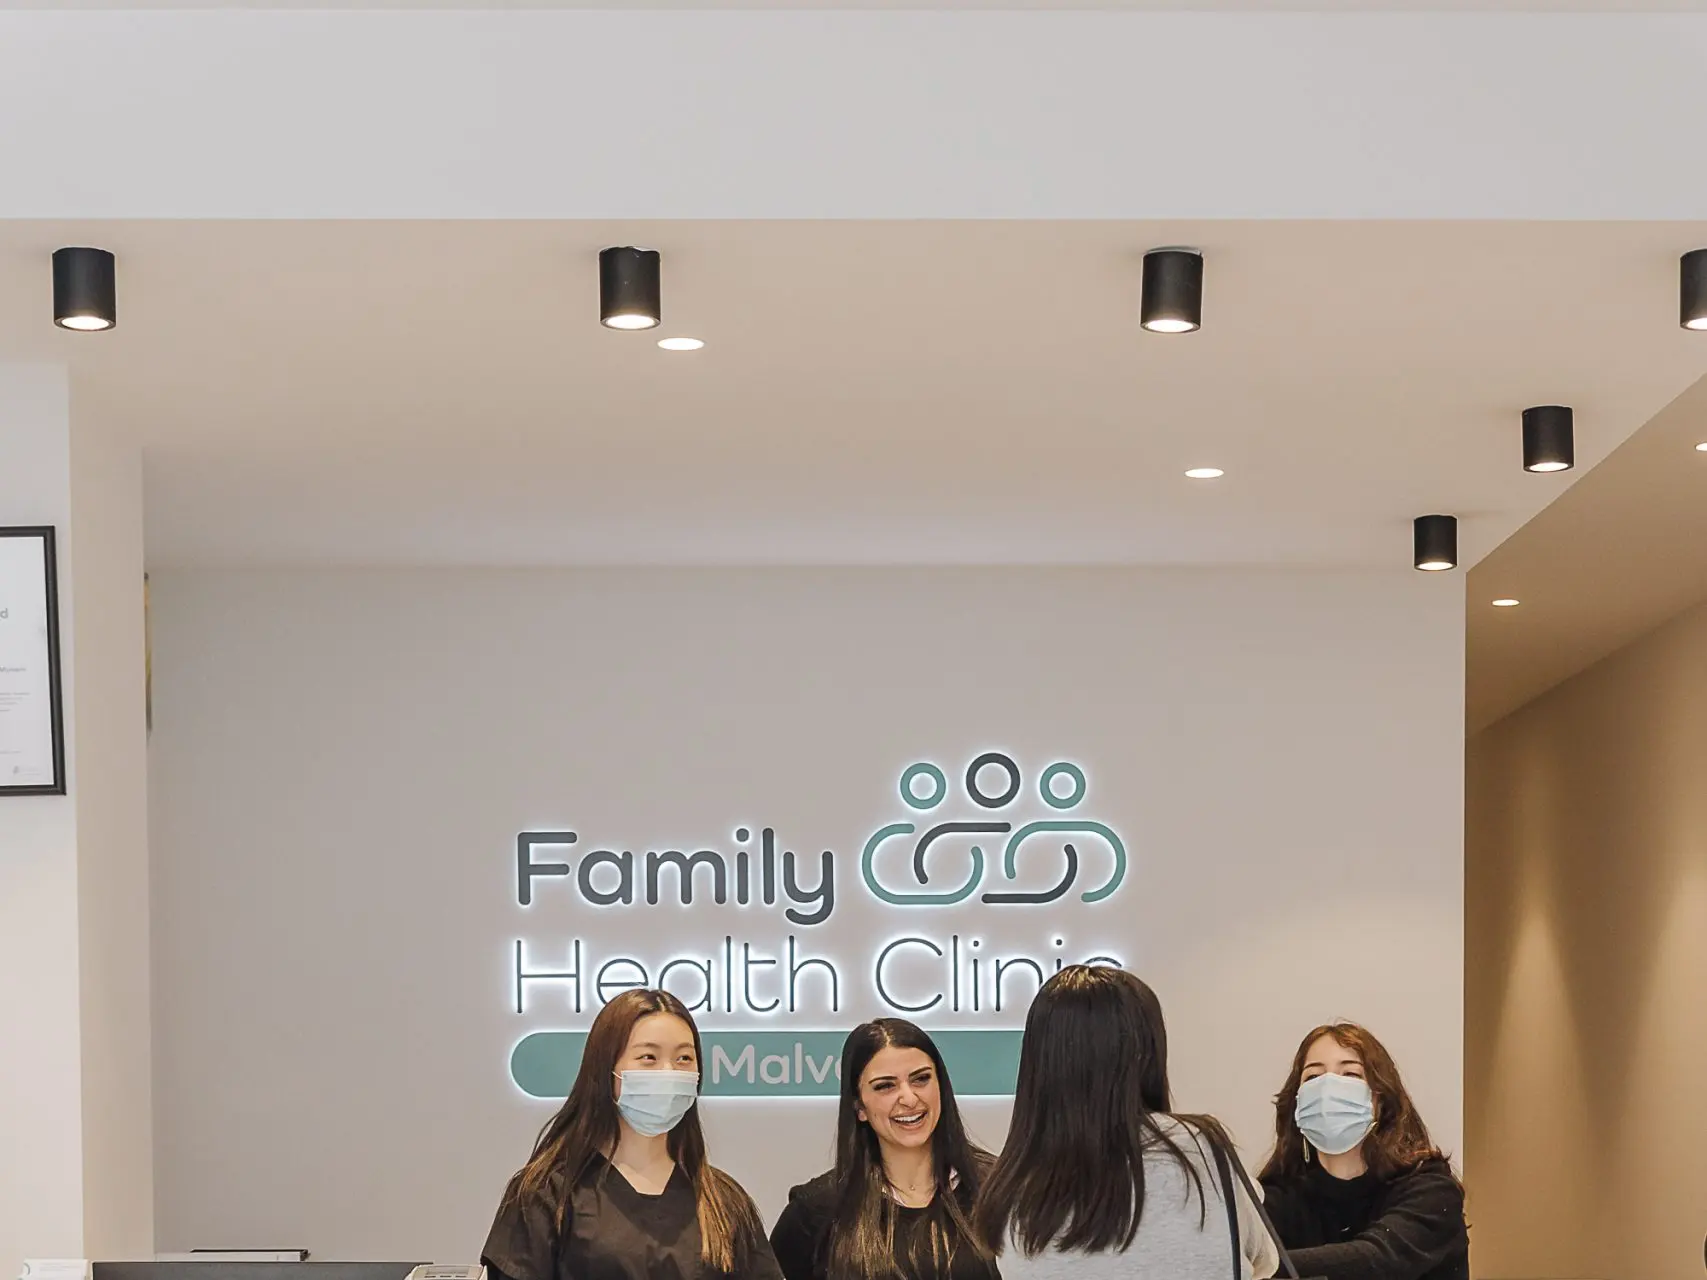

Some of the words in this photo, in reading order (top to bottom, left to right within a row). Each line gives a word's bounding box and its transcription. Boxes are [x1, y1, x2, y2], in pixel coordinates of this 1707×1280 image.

[517, 827, 835, 926] Family
[516, 935, 838, 1013] Health
[875, 934, 1123, 1012] Clin
[712, 1042, 842, 1085] Malv
